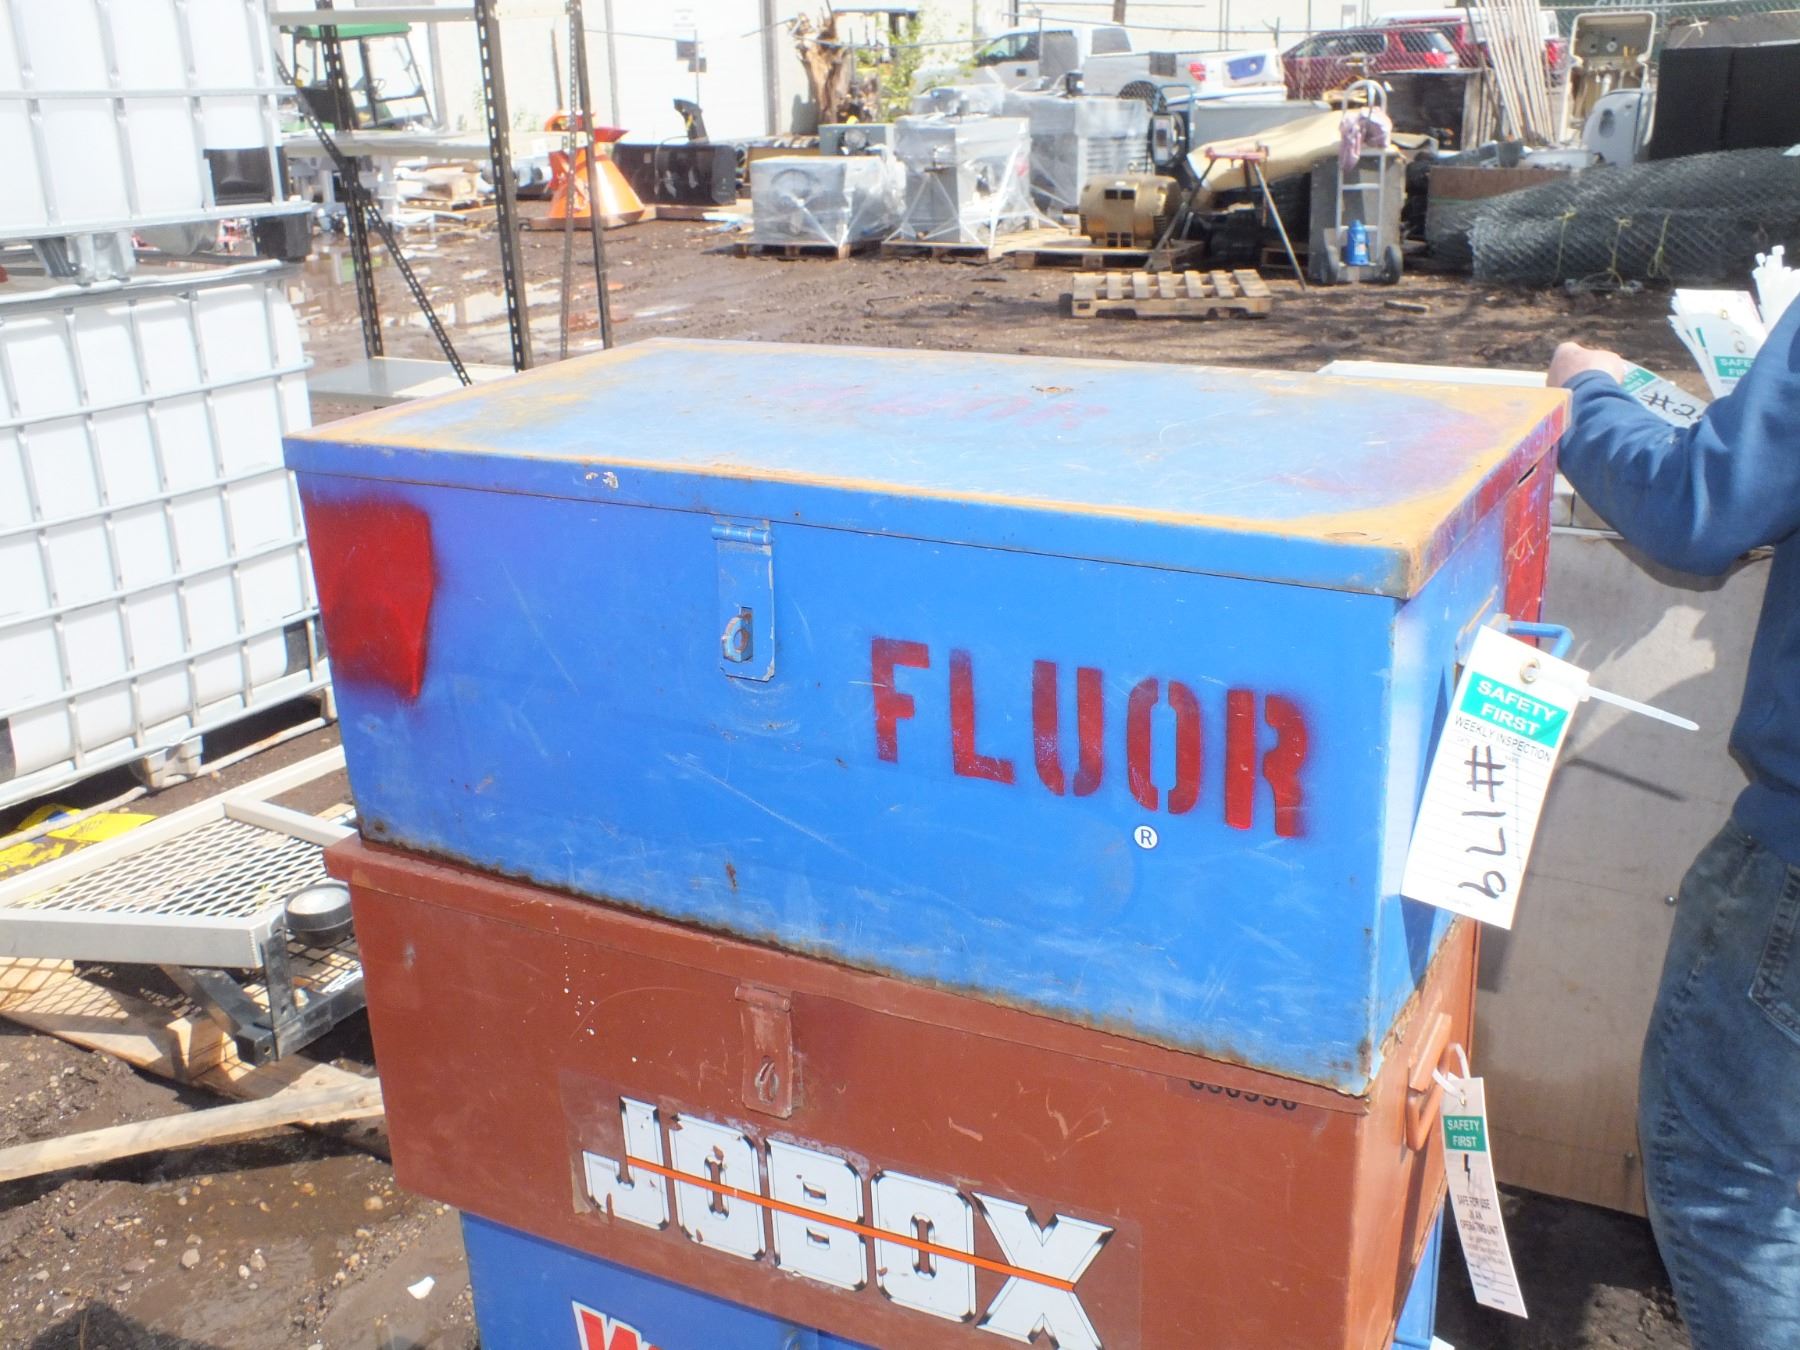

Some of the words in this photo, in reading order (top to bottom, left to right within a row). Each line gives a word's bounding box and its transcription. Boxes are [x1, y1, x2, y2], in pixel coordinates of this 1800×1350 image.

[1639, 391, 1703, 420] #2
[1476, 680, 1558, 722] SAFETY
[1480, 702, 1541, 736] FIRST
[871, 636, 1309, 838] FLUOR
[1455, 715, 1495, 738] WEEKLY
[1497, 732, 1551, 763] INSPECTION
[1447, 1119, 1480, 1132] SAFETY
[1452, 1135, 1478, 1148] FIRST
[582, 1095, 1116, 1350] JOBOX
